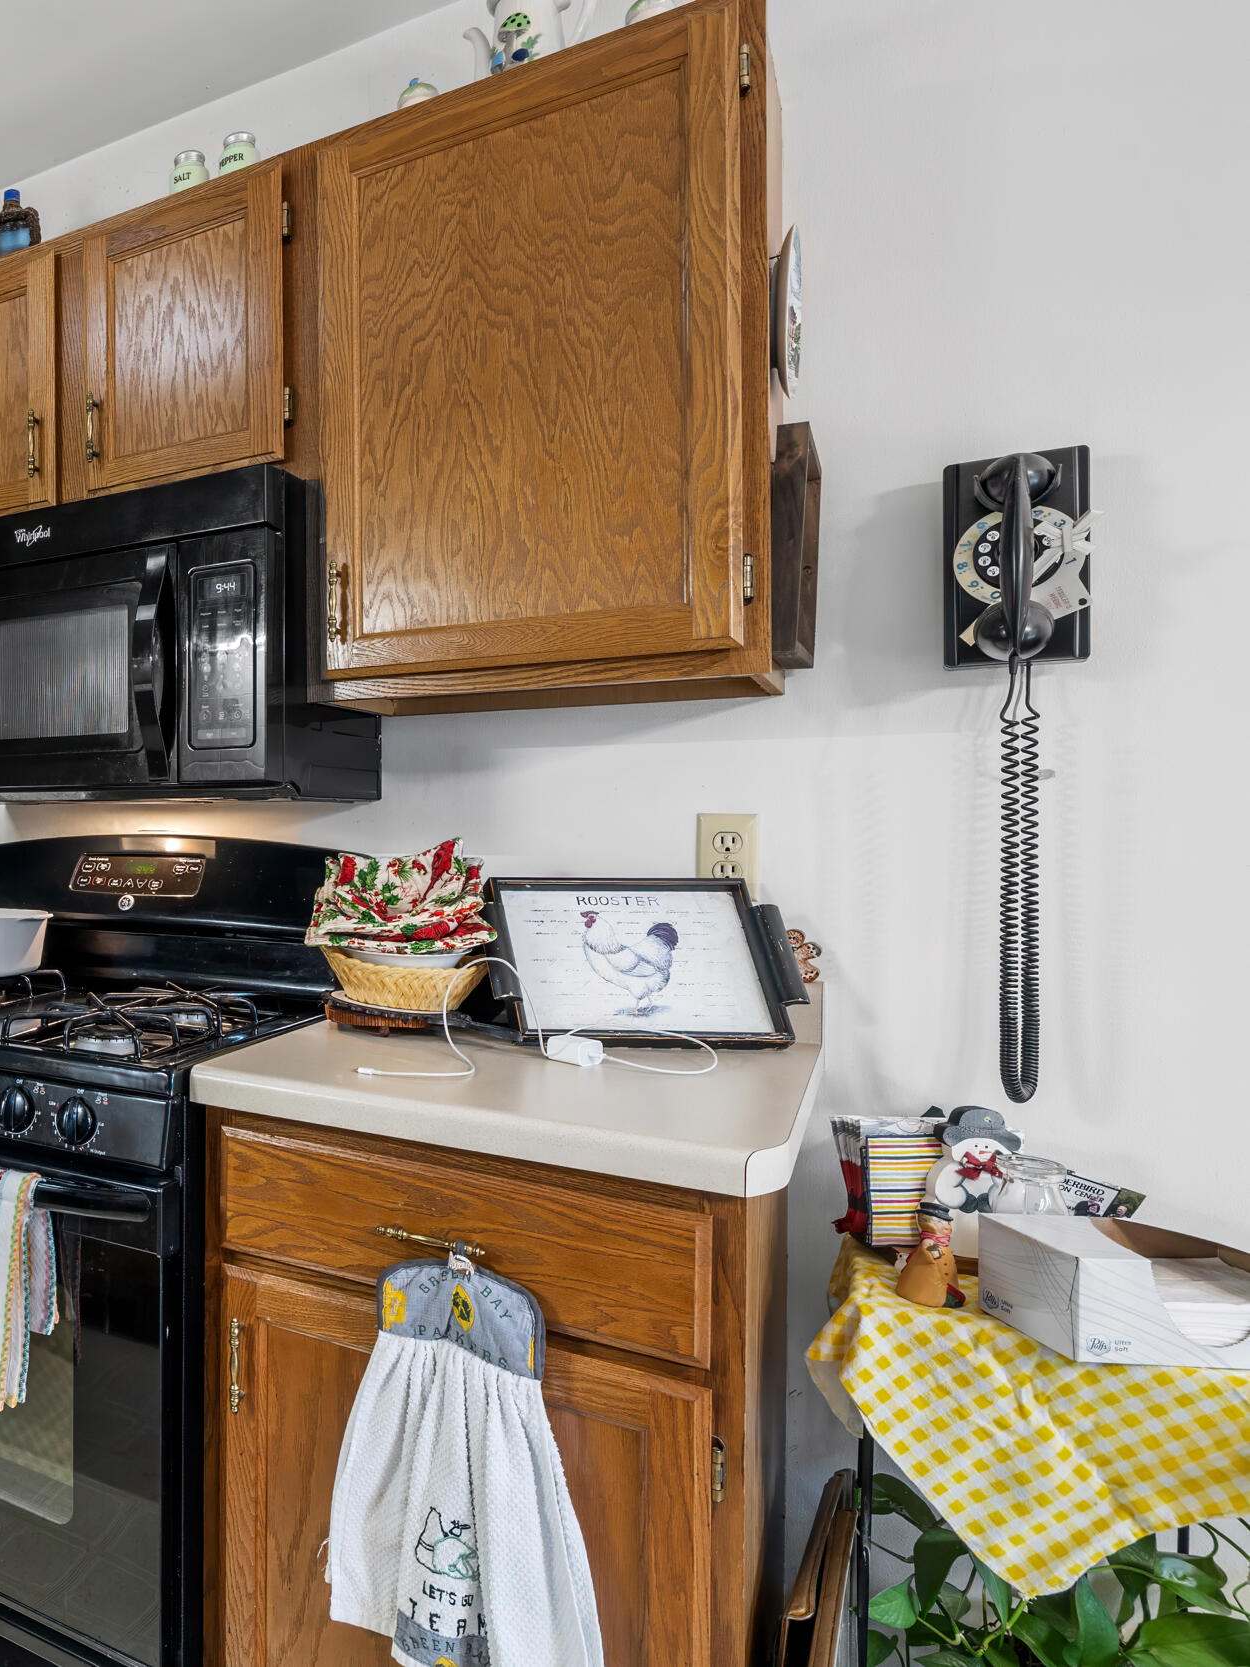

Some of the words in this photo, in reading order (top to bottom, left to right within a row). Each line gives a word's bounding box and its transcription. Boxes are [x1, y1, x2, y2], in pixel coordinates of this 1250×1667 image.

[173, 172, 192, 185] SALT
[976, 521, 988, 530] 6
[1054, 519, 1066, 528] 3
[14, 525, 50, 547] Whirlpool
[957, 561, 968, 570] 8
[1065, 557, 1077, 565] 1
[216, 582, 235, 593] 9:44
[966, 580, 979, 588] 9
[576, 895, 660, 907] ROOSTER
[418, 1269, 472, 1295] GREEN
[480, 1285, 513, 1320] BAY
[417, 1324, 510, 1370] PAKERS
[422, 1580, 457, 1607] LET'S
[461, 1594, 474, 1607] GO
[401, 1636, 455, 1654] GREEN
